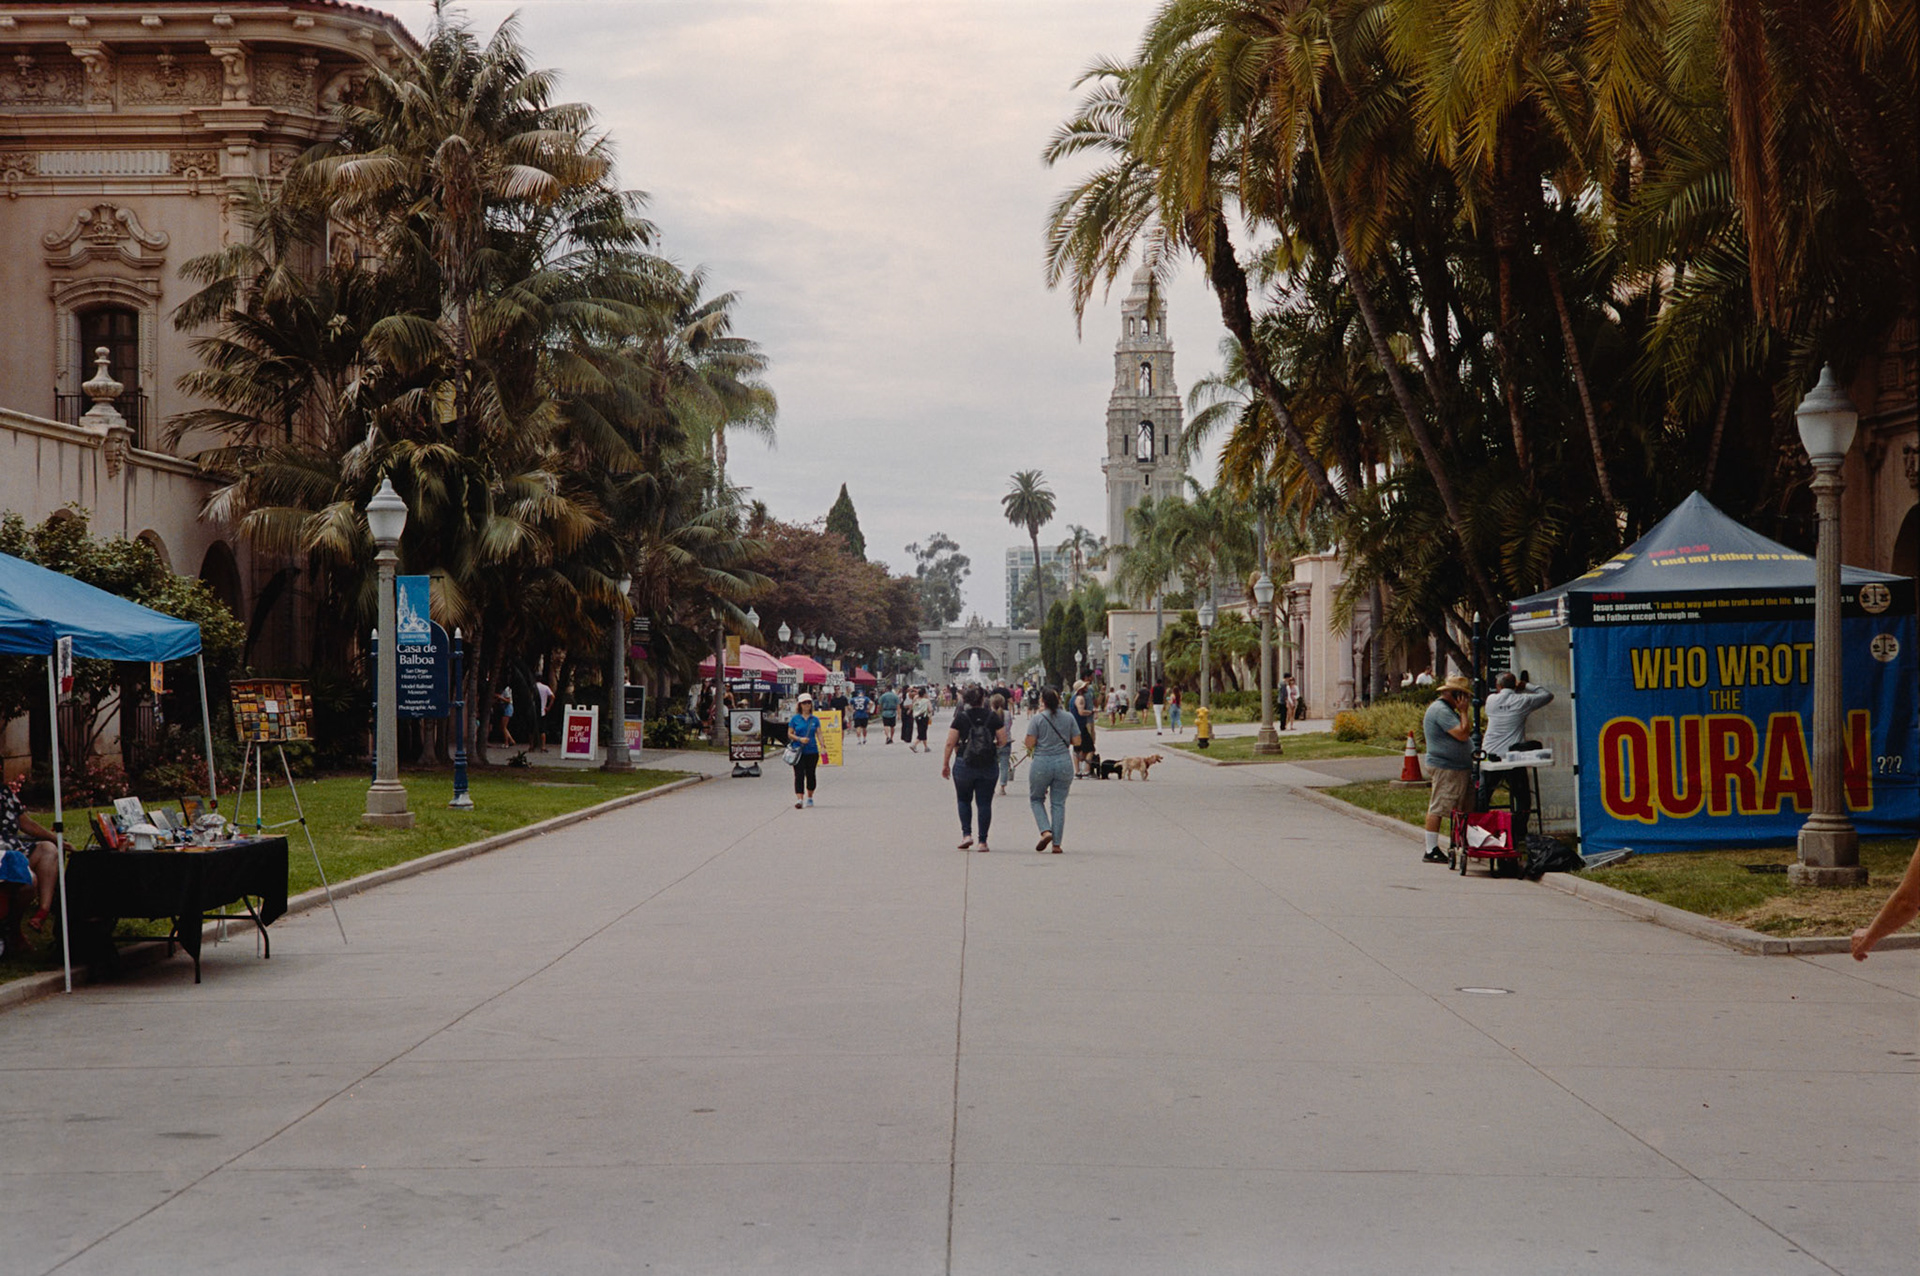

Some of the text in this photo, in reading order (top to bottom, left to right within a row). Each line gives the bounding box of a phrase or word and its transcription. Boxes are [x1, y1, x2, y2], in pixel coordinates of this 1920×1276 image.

[1660, 556, 1686, 566] and
[1689, 555, 1708, 564] my
[1711, 552, 1754, 562] Father
[1593, 604, 1613, 612] Jesus
[1615, 602, 1653, 612] answered,
[1687, 602, 1702, 610] way
[1593, 613, 1605, 622] the
[1607, 613, 1630, 621] Father
[1631, 613, 1656, 621] except
[1657, 612, 1686, 620] through
[397, 644, 437, 653] Casa de
[400, 654, 434, 664] Balboa
[1630, 643, 1815, 690] WHO WROT
[855, 702, 864, 710] 35
[1710, 690, 1741, 710] THE
[1599, 709, 1873, 824] QURAN
[1877, 756, 1902, 774] ???
